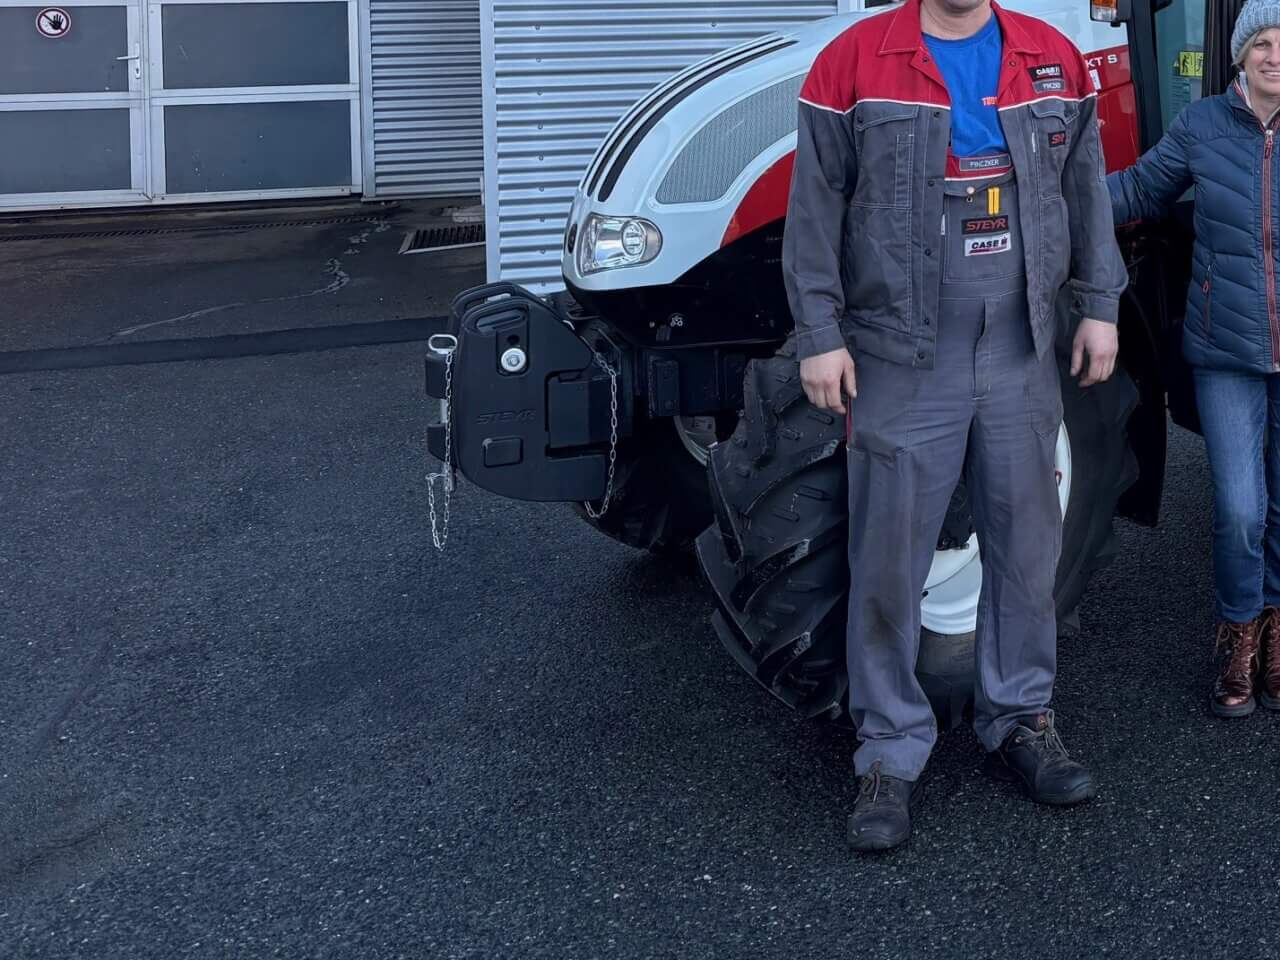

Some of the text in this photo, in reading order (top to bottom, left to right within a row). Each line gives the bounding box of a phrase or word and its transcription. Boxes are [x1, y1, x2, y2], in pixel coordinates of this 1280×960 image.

[1107, 54, 1118, 64] S
[966, 218, 1007, 231] STEYR
[971, 239, 1000, 250] CASE
